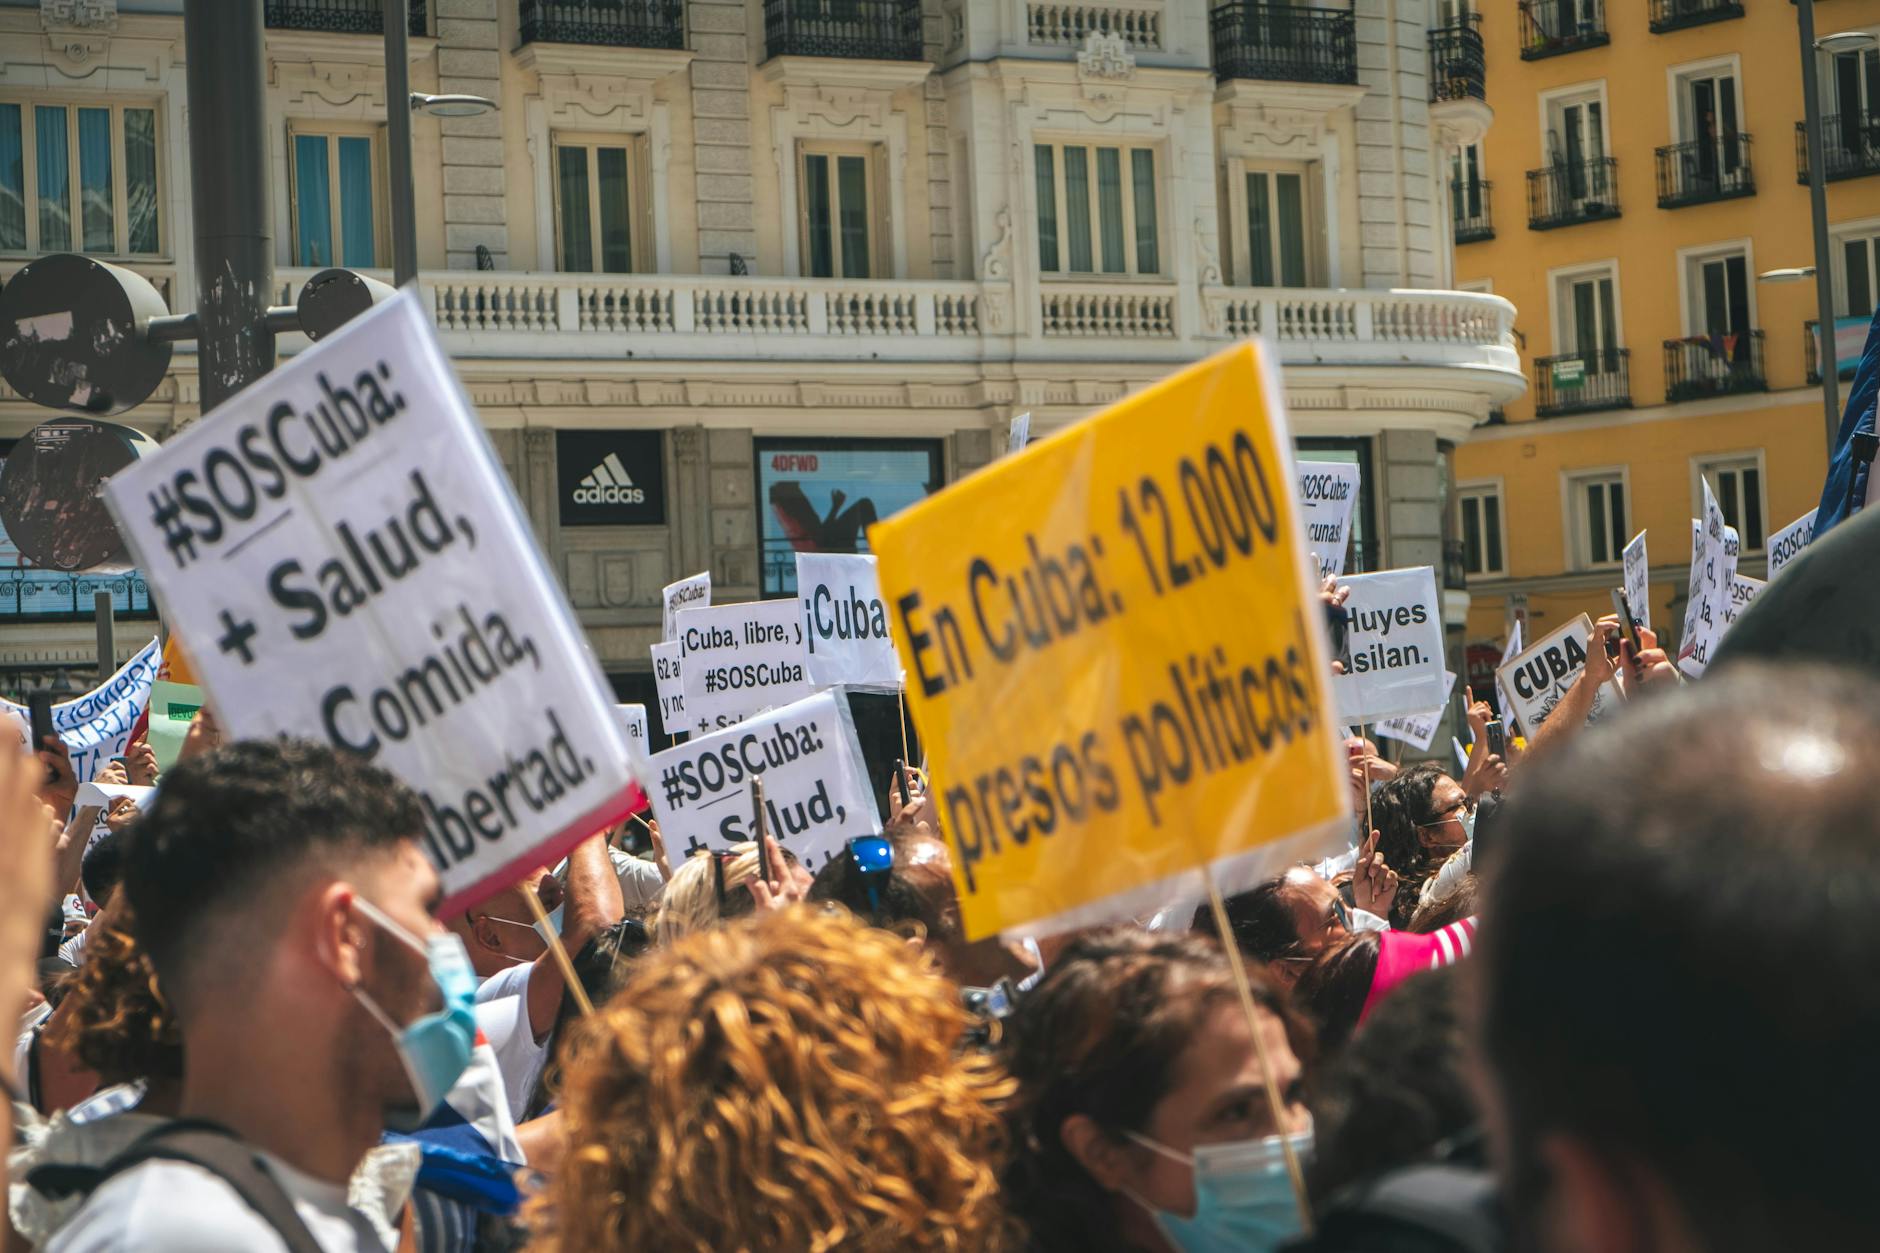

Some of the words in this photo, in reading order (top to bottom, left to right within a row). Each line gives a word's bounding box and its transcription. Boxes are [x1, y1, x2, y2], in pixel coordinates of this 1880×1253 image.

[147, 361, 406, 568] #SOSCuba:
[573, 486, 645, 504] adidas
[771, 454, 819, 472] 4DFWD
[1299, 473, 1350, 500] SOSCuba:
[268, 470, 477, 641] Salud,
[898, 591, 974, 699] En
[967, 533, 1124, 664] Cuba:
[1117, 428, 1277, 597] 12.000
[321, 602, 540, 762] Comida,
[656, 656, 671, 681] 62
[681, 626, 739, 657] ¡Cuba,
[744, 621, 789, 645] libre,
[1513, 635, 1586, 699] CUBA
[422, 708, 597, 872] ibertad.
[661, 721, 824, 811] #SOSCuba:
[946, 728, 1117, 895] presos
